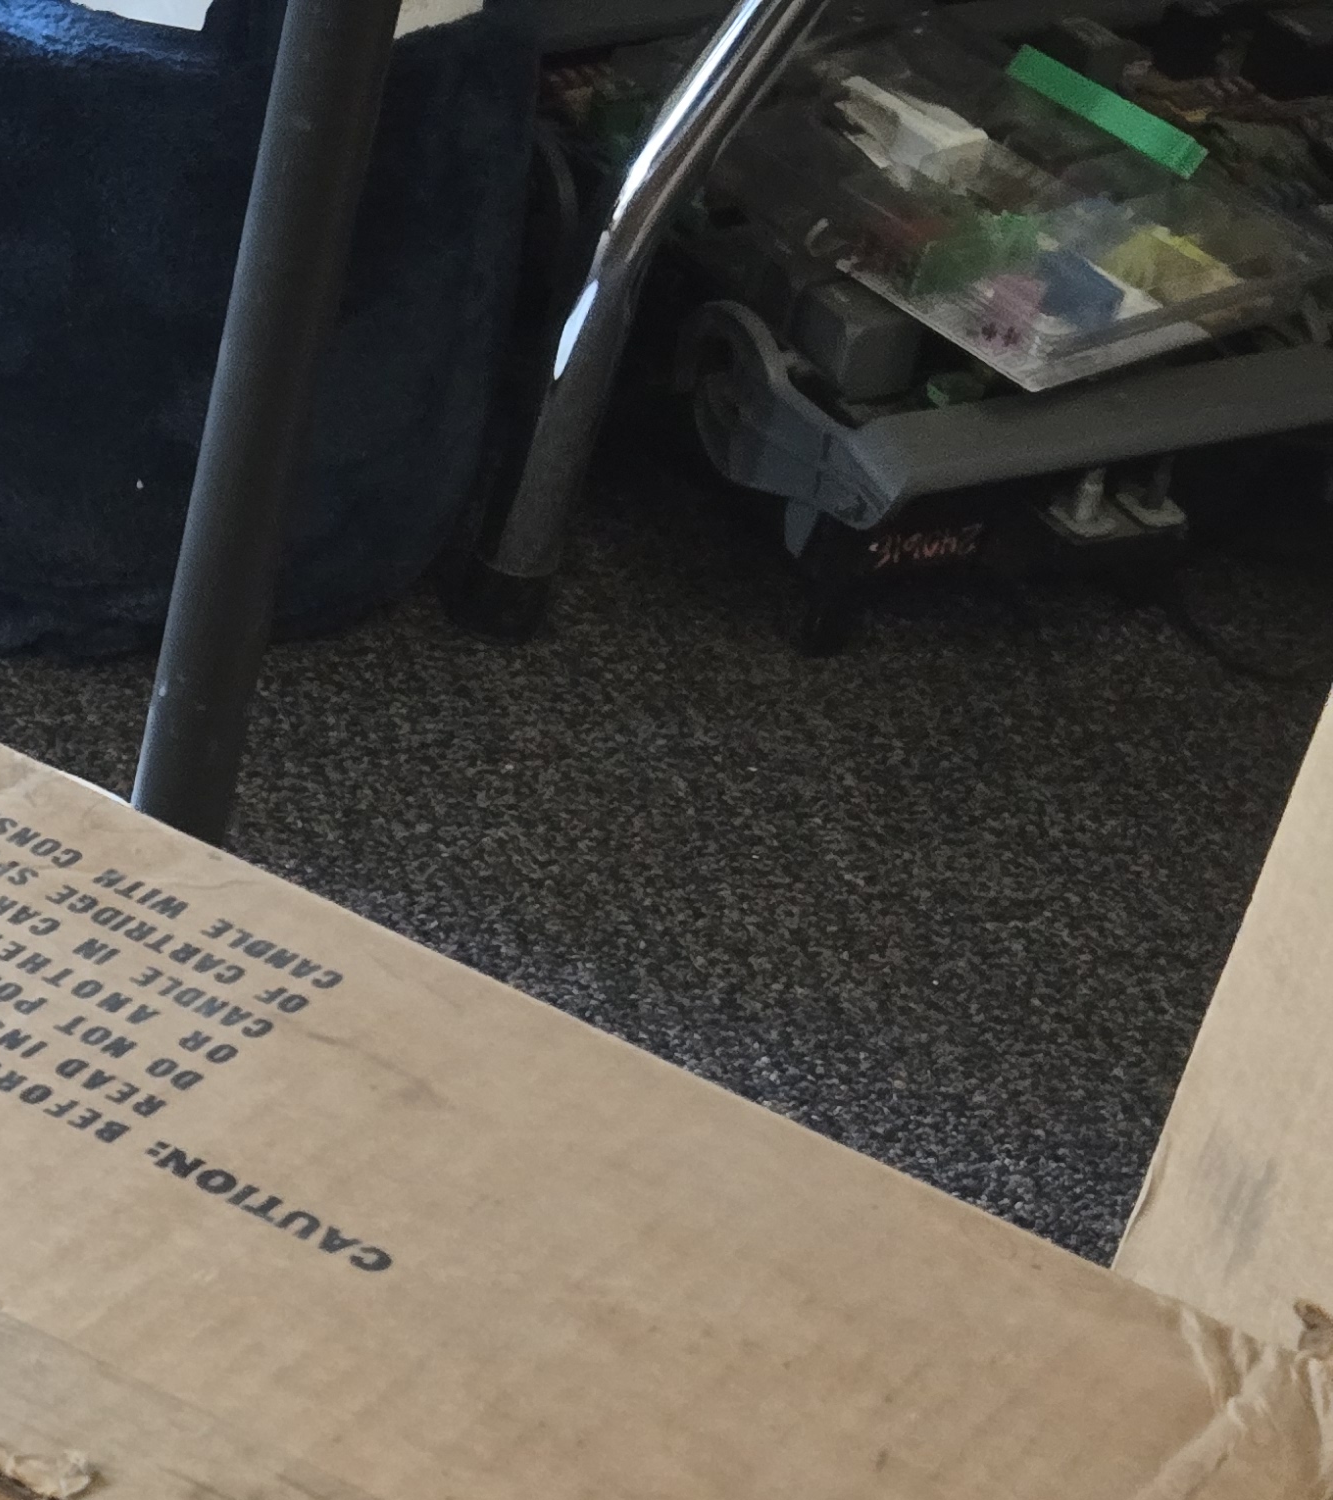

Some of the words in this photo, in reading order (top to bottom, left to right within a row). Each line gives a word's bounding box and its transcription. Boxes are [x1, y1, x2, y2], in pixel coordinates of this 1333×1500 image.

[93, 867, 189, 919] WITH
[45, 884, 246, 985] CARTRIDGE
[73, 937, 120, 965] IN
[202, 917, 343, 990] CANDLE
[129, 965, 274, 1040] CANDLE
[252, 987, 310, 1014] OF
[54, 1013, 138, 1059] NOT
[178, 1029, 239, 1064] OR
[54, 1057, 168, 1120] READ
[145, 1057, 205, 1092] DO
[144, 1139, 394, 1274] CAUTION:
